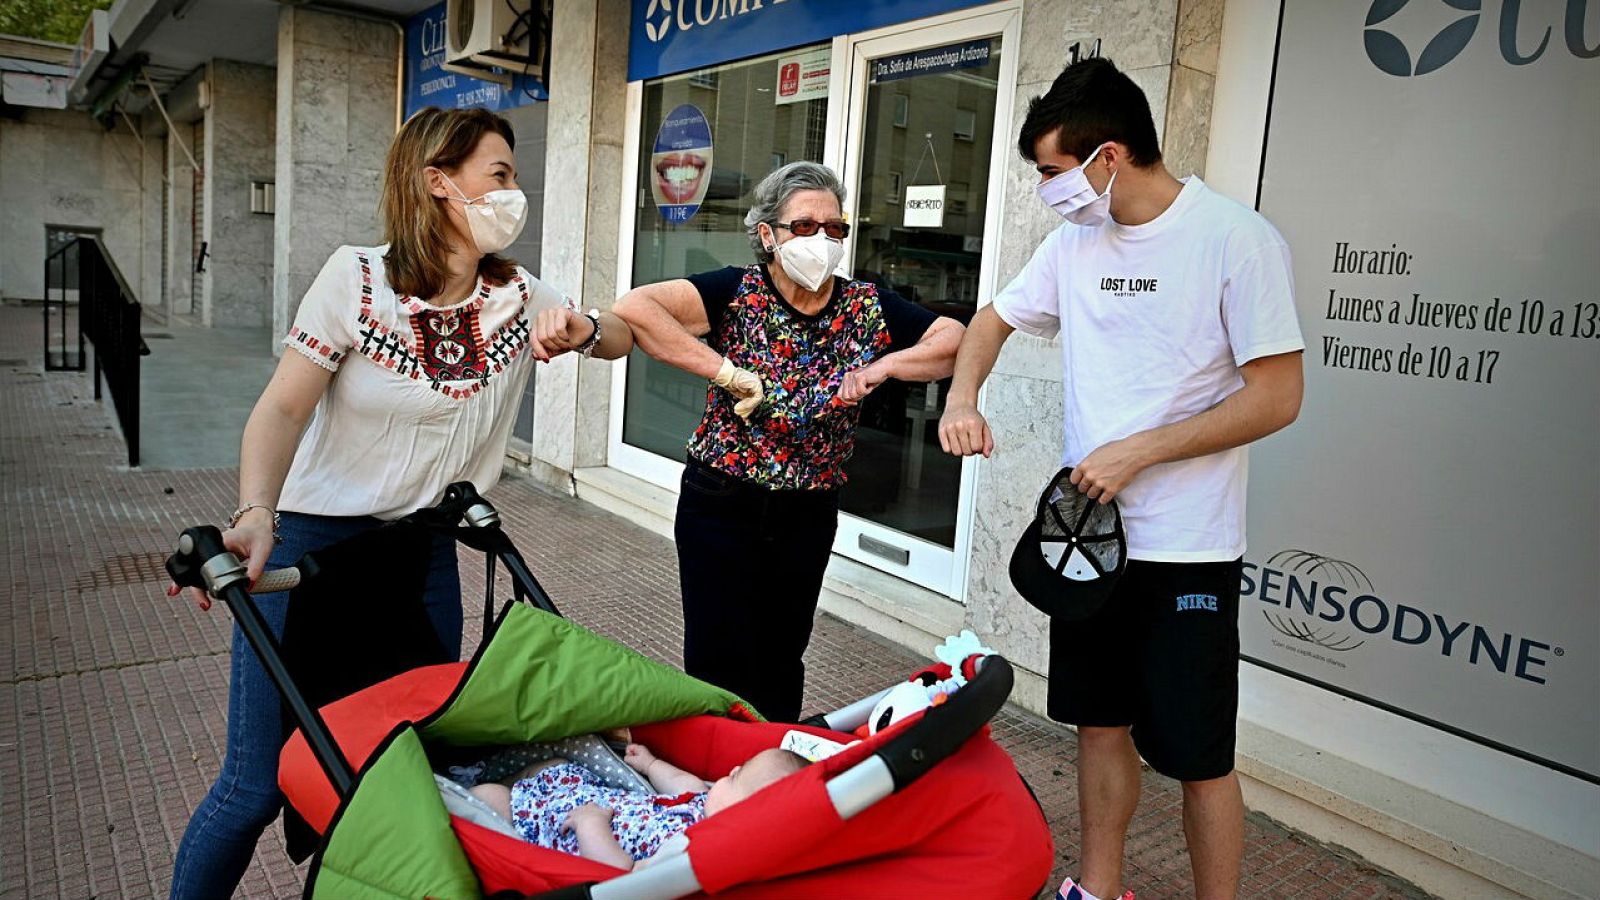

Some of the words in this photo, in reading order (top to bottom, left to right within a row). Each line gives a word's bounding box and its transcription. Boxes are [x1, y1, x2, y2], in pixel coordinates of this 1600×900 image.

[421, 12, 445, 56] CLÍ
[905, 57, 913, 71] de
[1333, 242, 1413, 275] Horario:
[1100, 278, 1126, 291] LOST
[1128, 278, 1158, 293] LOVE
[1325, 289, 1384, 324] Lunes
[1388, 300, 1401, 326] a
[1404, 293, 1479, 330] Jueves
[1484, 297, 1512, 333] de
[1516, 299, 1545, 335] 10
[1549, 309, 1565, 337] a
[1322, 336, 1393, 374] Viernes
[1398, 342, 1423, 377] de
[1427, 345, 1452, 379] 10
[1455, 356, 1470, 382] a
[1474, 350, 1500, 384] 17
[1176, 594, 1218, 612] NIKE
